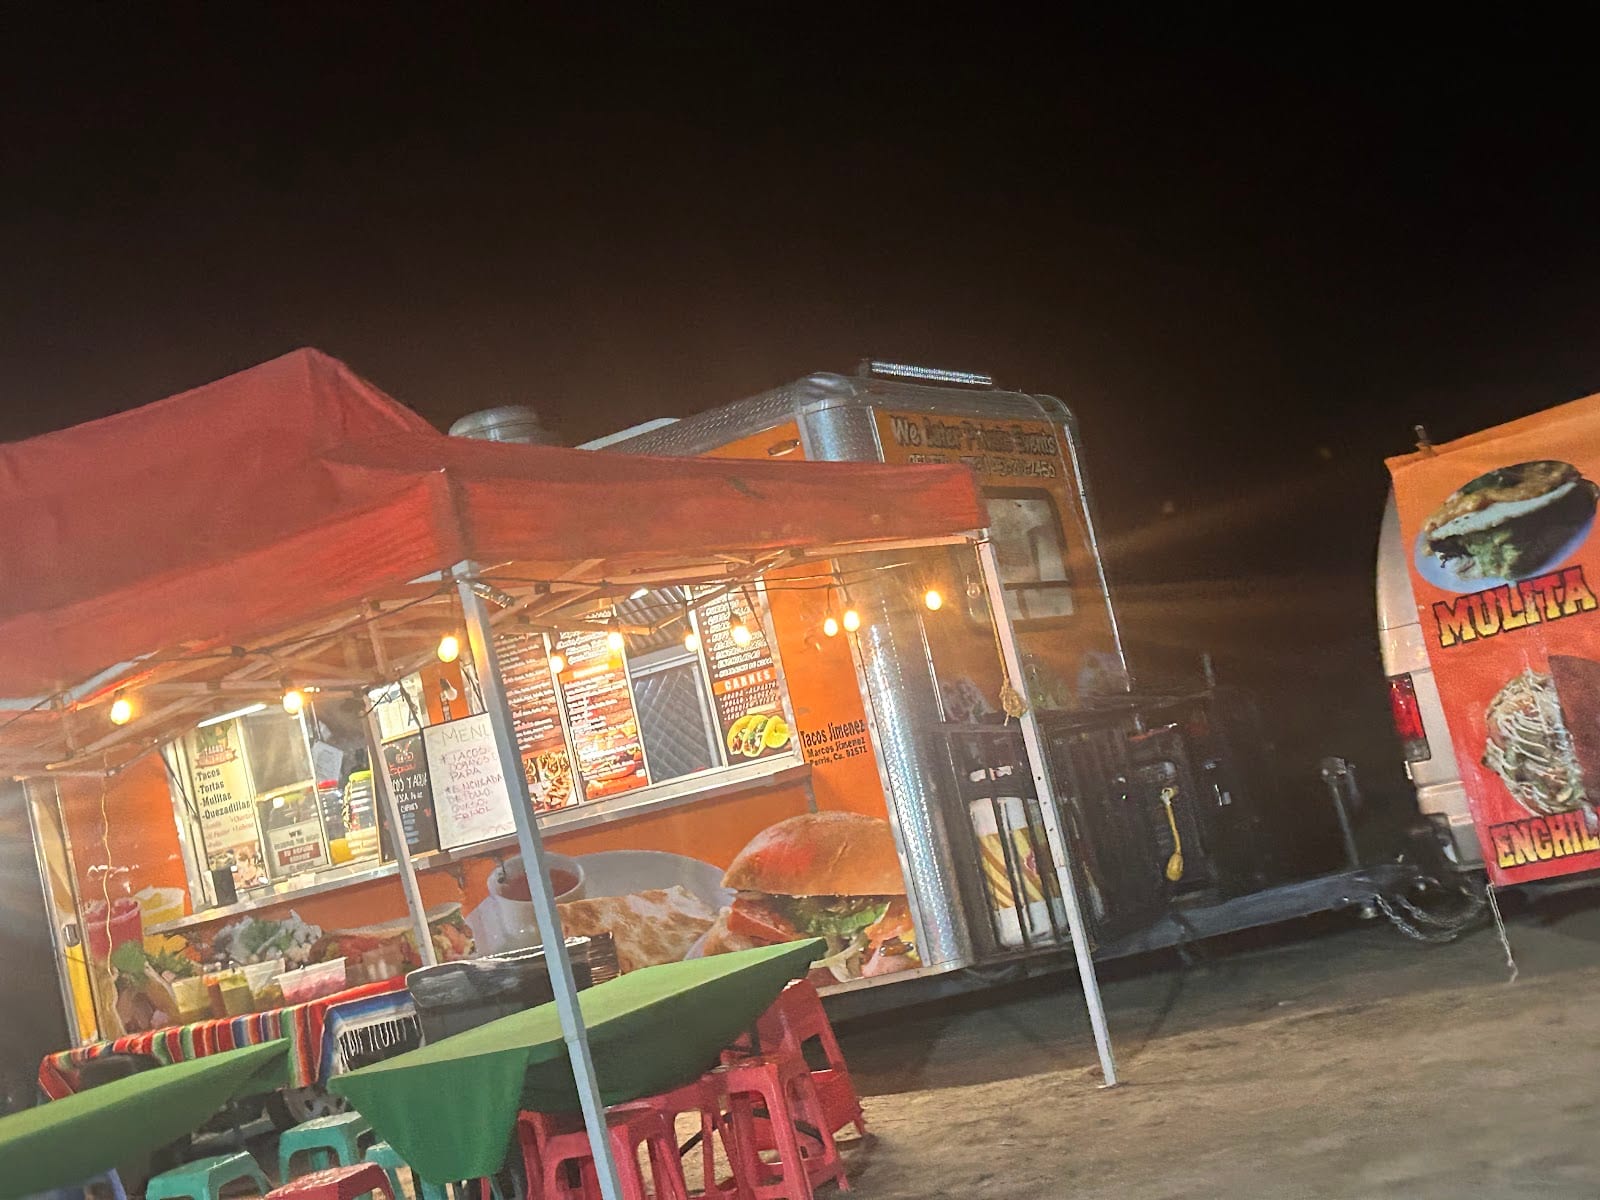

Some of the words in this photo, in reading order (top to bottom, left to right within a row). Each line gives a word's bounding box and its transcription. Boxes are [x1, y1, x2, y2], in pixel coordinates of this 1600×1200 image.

[1432, 565, 1598, 648] MULITA
[724, 669, 771, 691] CARNES
[800, 729, 828, 748] Tacos
[828, 720, 866, 741] Jimenez
[806, 746, 835, 758] Marcos
[453, 773, 504, 793] ENCHILADA
[1489, 808, 1600, 869] ENCHIL
